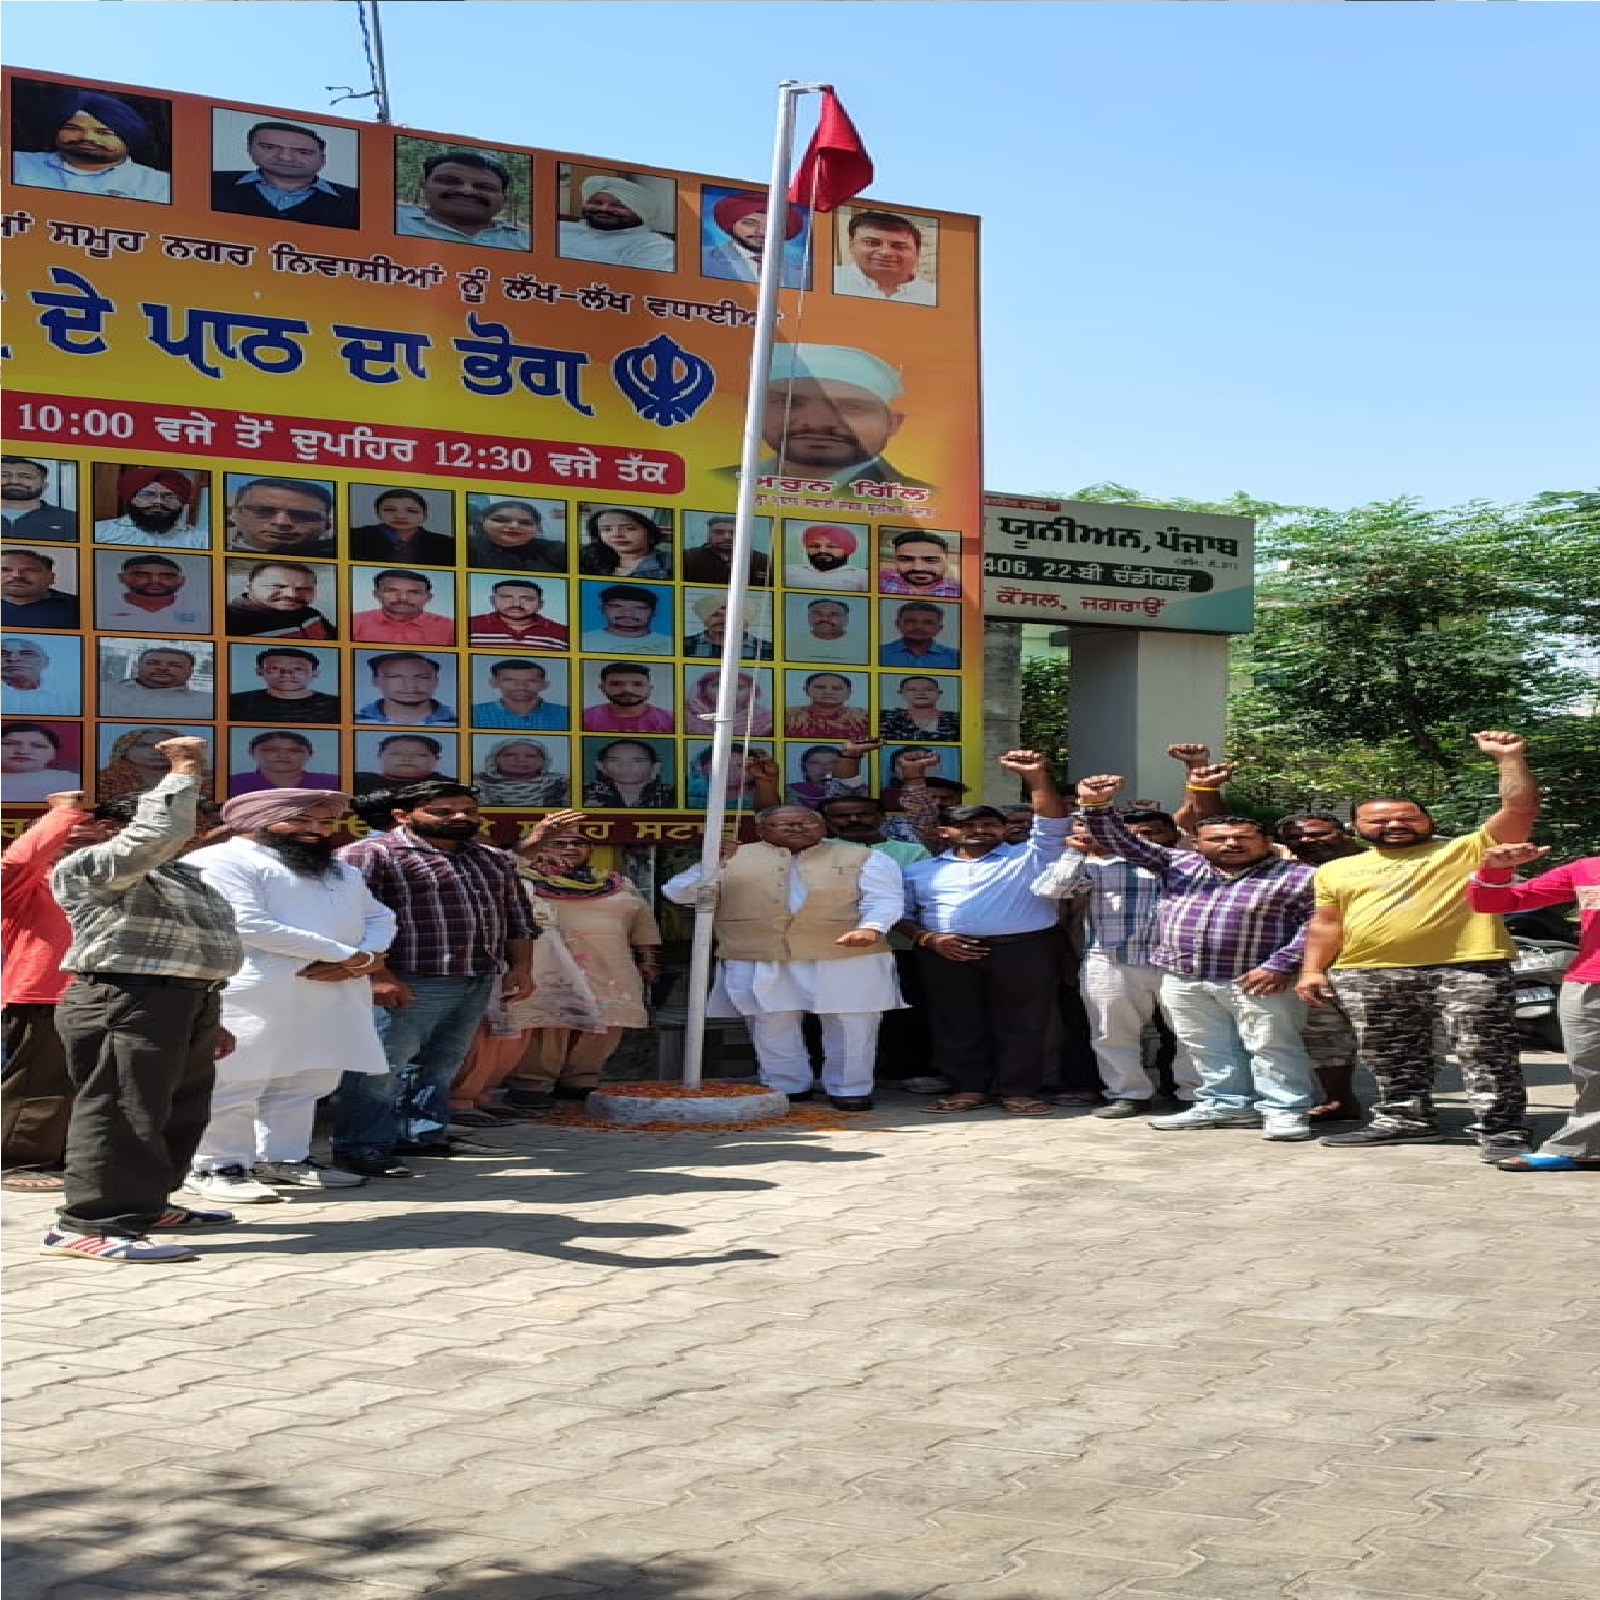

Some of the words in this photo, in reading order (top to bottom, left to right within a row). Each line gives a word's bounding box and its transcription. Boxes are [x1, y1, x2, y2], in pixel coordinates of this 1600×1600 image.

[160, 234, 256, 267] ਨਗਰ
[268, 241, 447, 290] ਨਿਵਾਸੀਆਂ
[29, 266, 117, 356] ਦੇ
[138, 302, 313, 380] ਪਾਠ
[330, 322, 433, 385] ਦਾ
[450, 311, 597, 418] ਭੋਗ
[18, 403, 136, 439] 10:00
[153, 411, 217, 446] ਵਜੇ
[233, 414, 276, 449] ਤੋਂ
[288, 426, 418, 462] ਦੁਪਹਿਰ
[433, 441, 533, 473] 12:30
[547, 447, 602, 480] ਵਜੇ
[613, 452, 670, 485] ਤੱਕ
